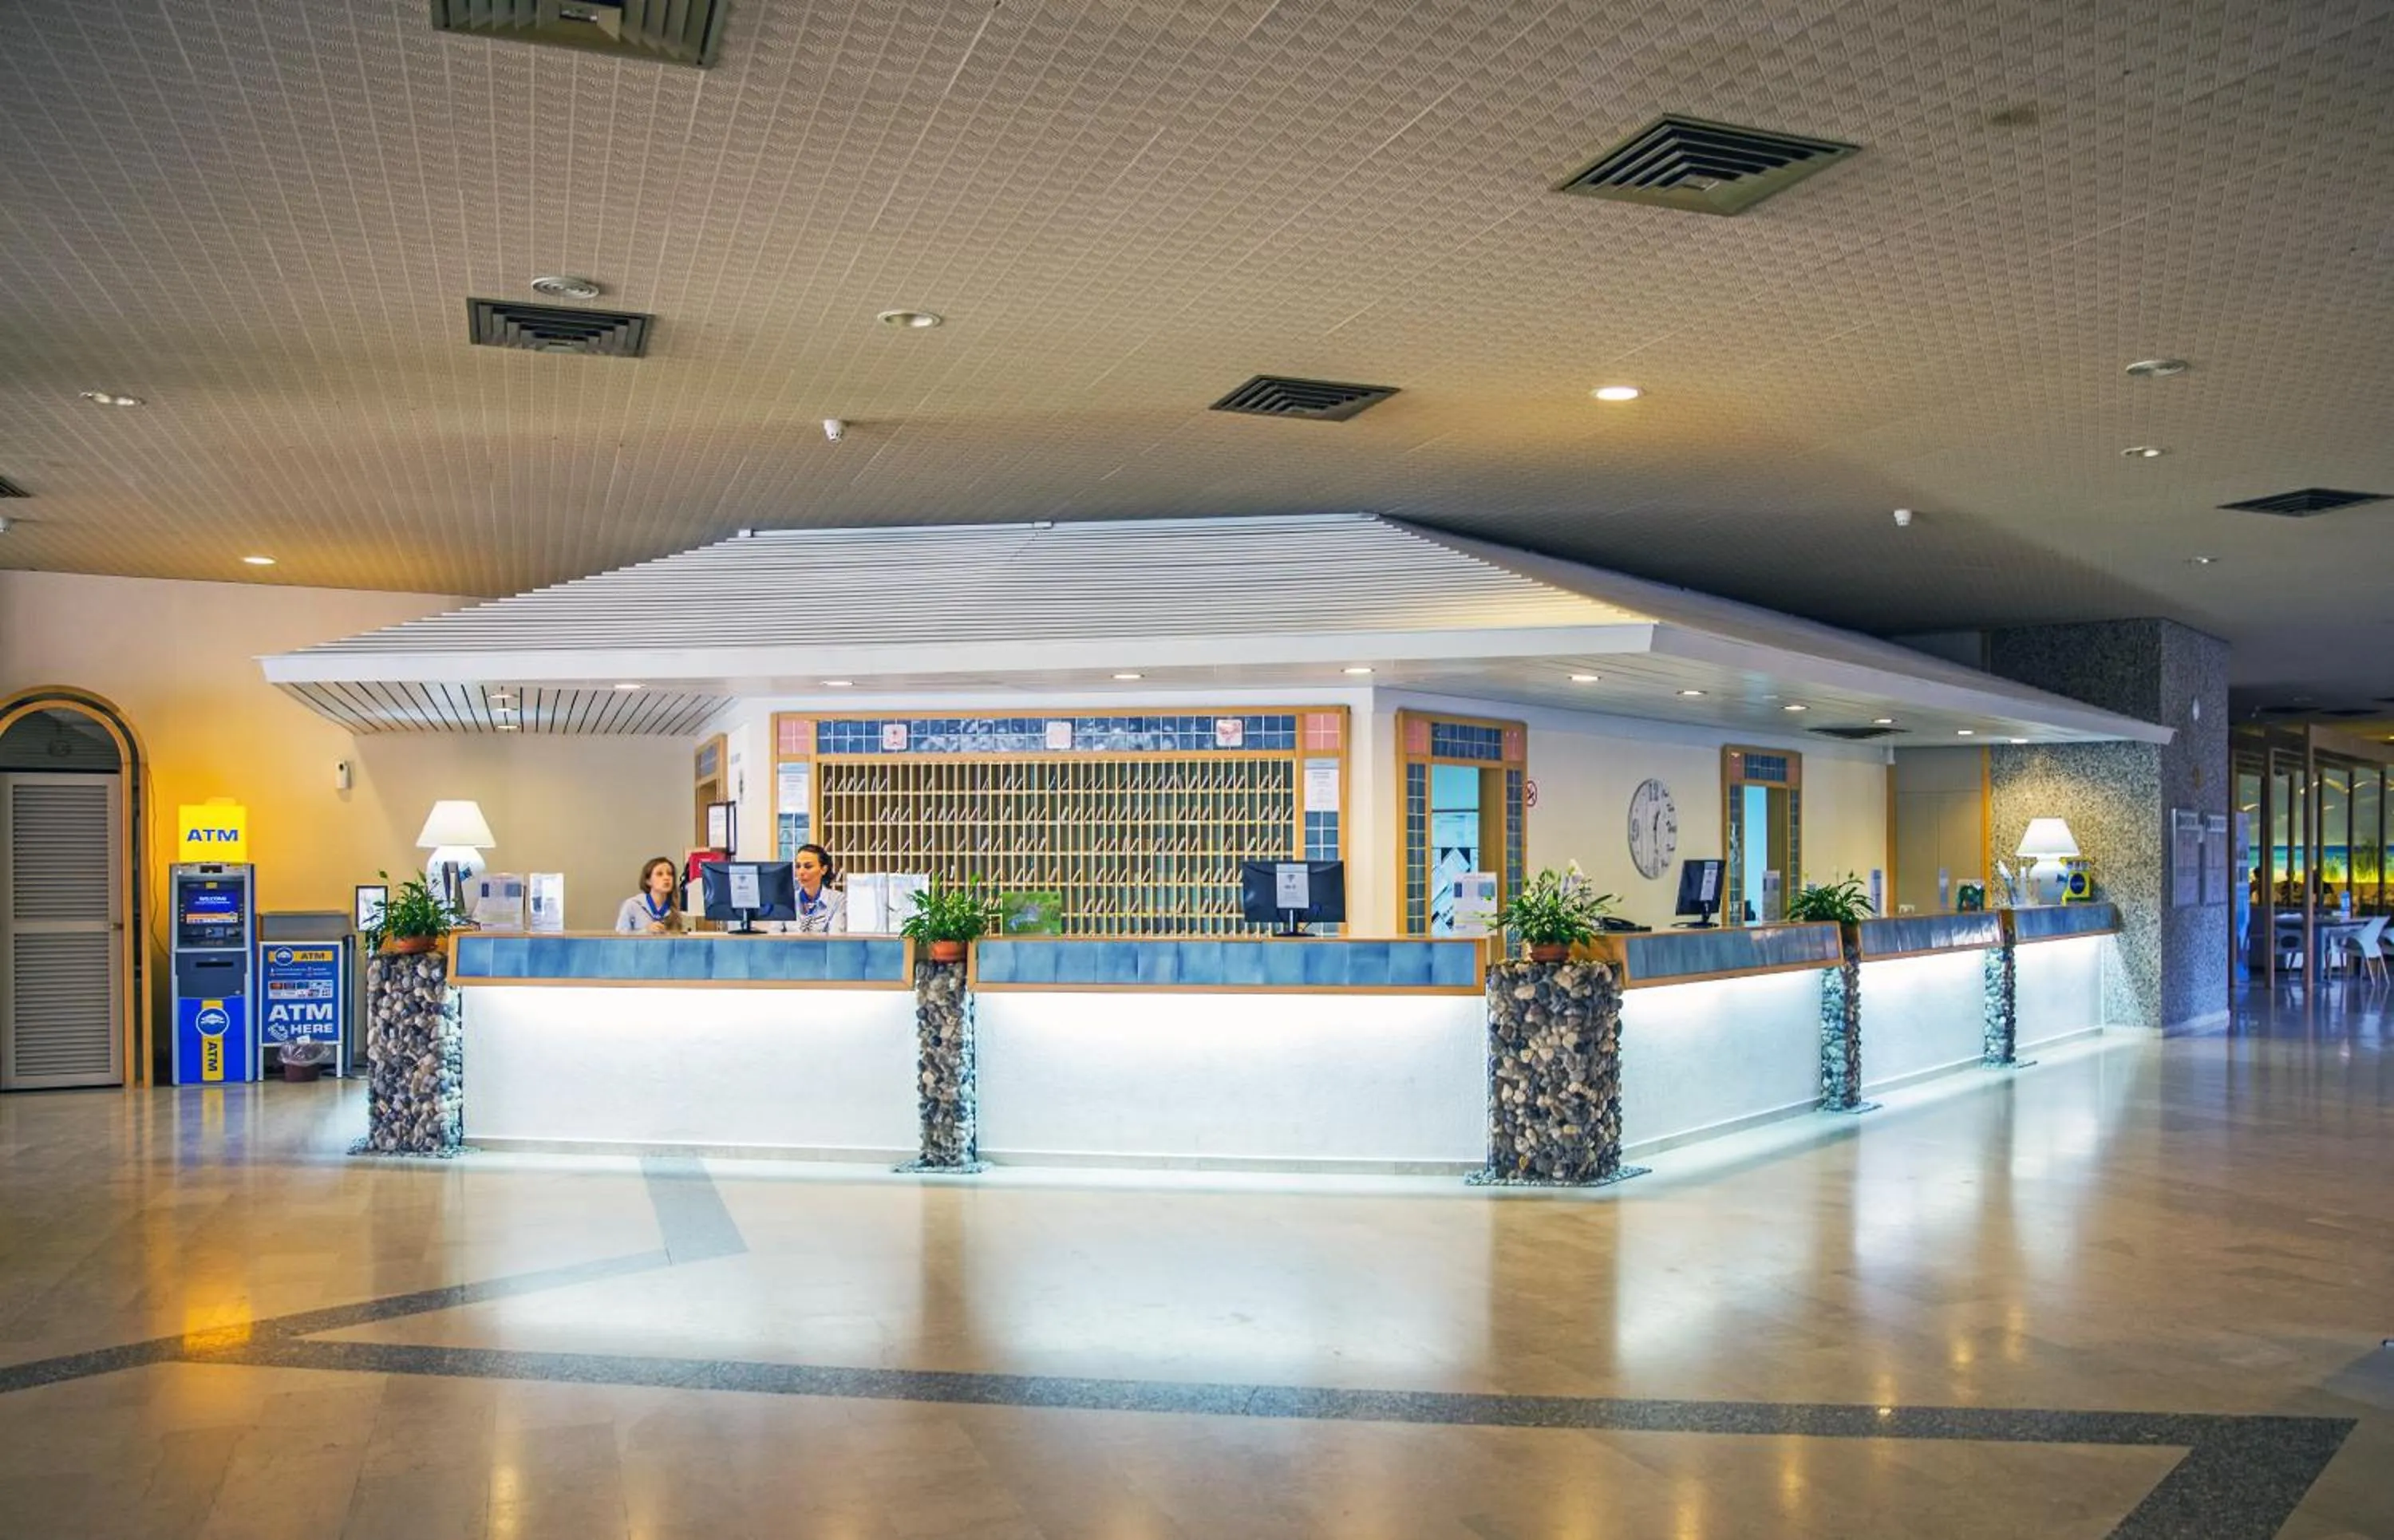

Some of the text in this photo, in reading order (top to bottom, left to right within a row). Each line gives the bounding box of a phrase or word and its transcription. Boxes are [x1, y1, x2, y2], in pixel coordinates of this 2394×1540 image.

[187, 829, 239, 842] ATM
[268, 1004, 333, 1021] ATM
[290, 1024, 333, 1035] HERE
[207, 1040, 218, 1072] ATM
